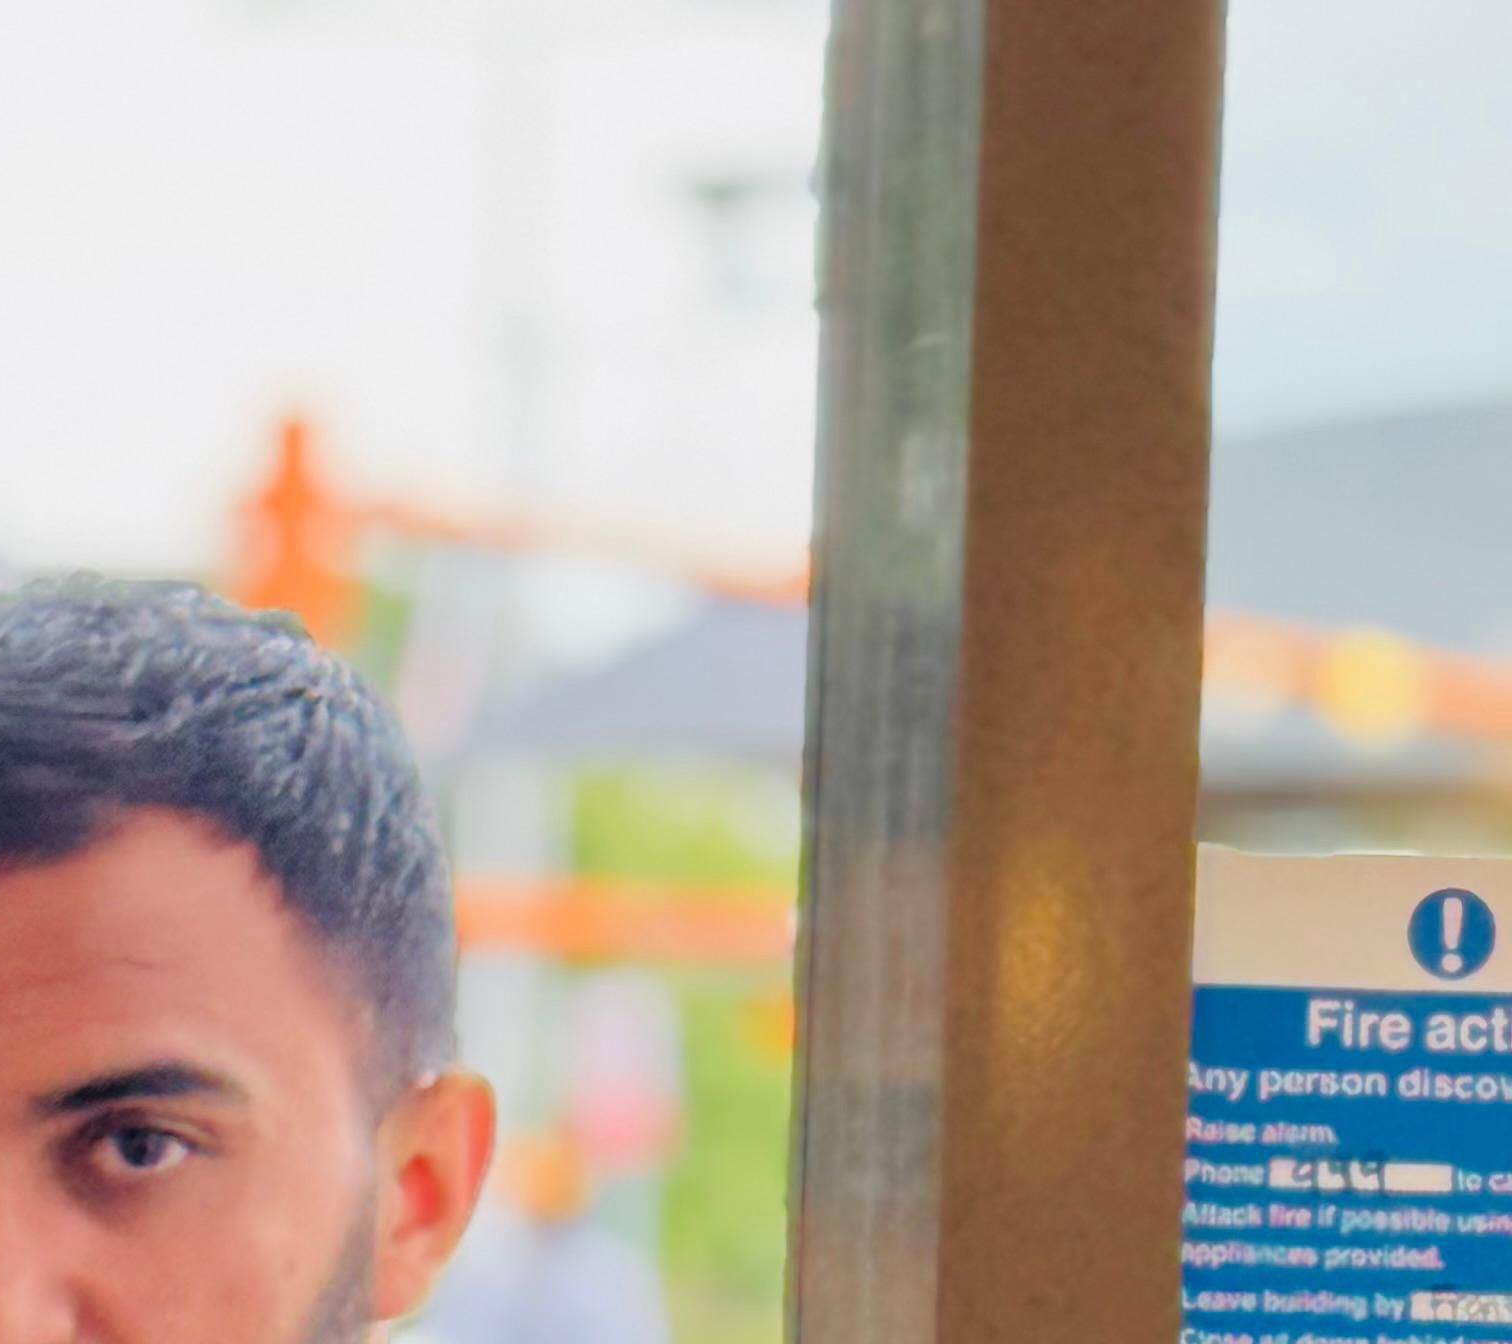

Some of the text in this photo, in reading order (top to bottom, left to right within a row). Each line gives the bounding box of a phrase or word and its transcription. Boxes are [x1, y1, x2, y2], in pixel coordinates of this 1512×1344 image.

[1307, 999, 1512, 1052] Fire act
[1188, 1062, 1249, 1100] Any
[1259, 1069, 1387, 1101] person
[1185, 1117, 1256, 1143] Raise
[1183, 1158, 1264, 1185] Phone
[1182, 1202, 1512, 1235] Attack fire if possible usin
[1181, 1288, 1256, 1312] Leave
[1264, 1290, 1367, 1321] building
[1374, 1293, 1404, 1320] by
